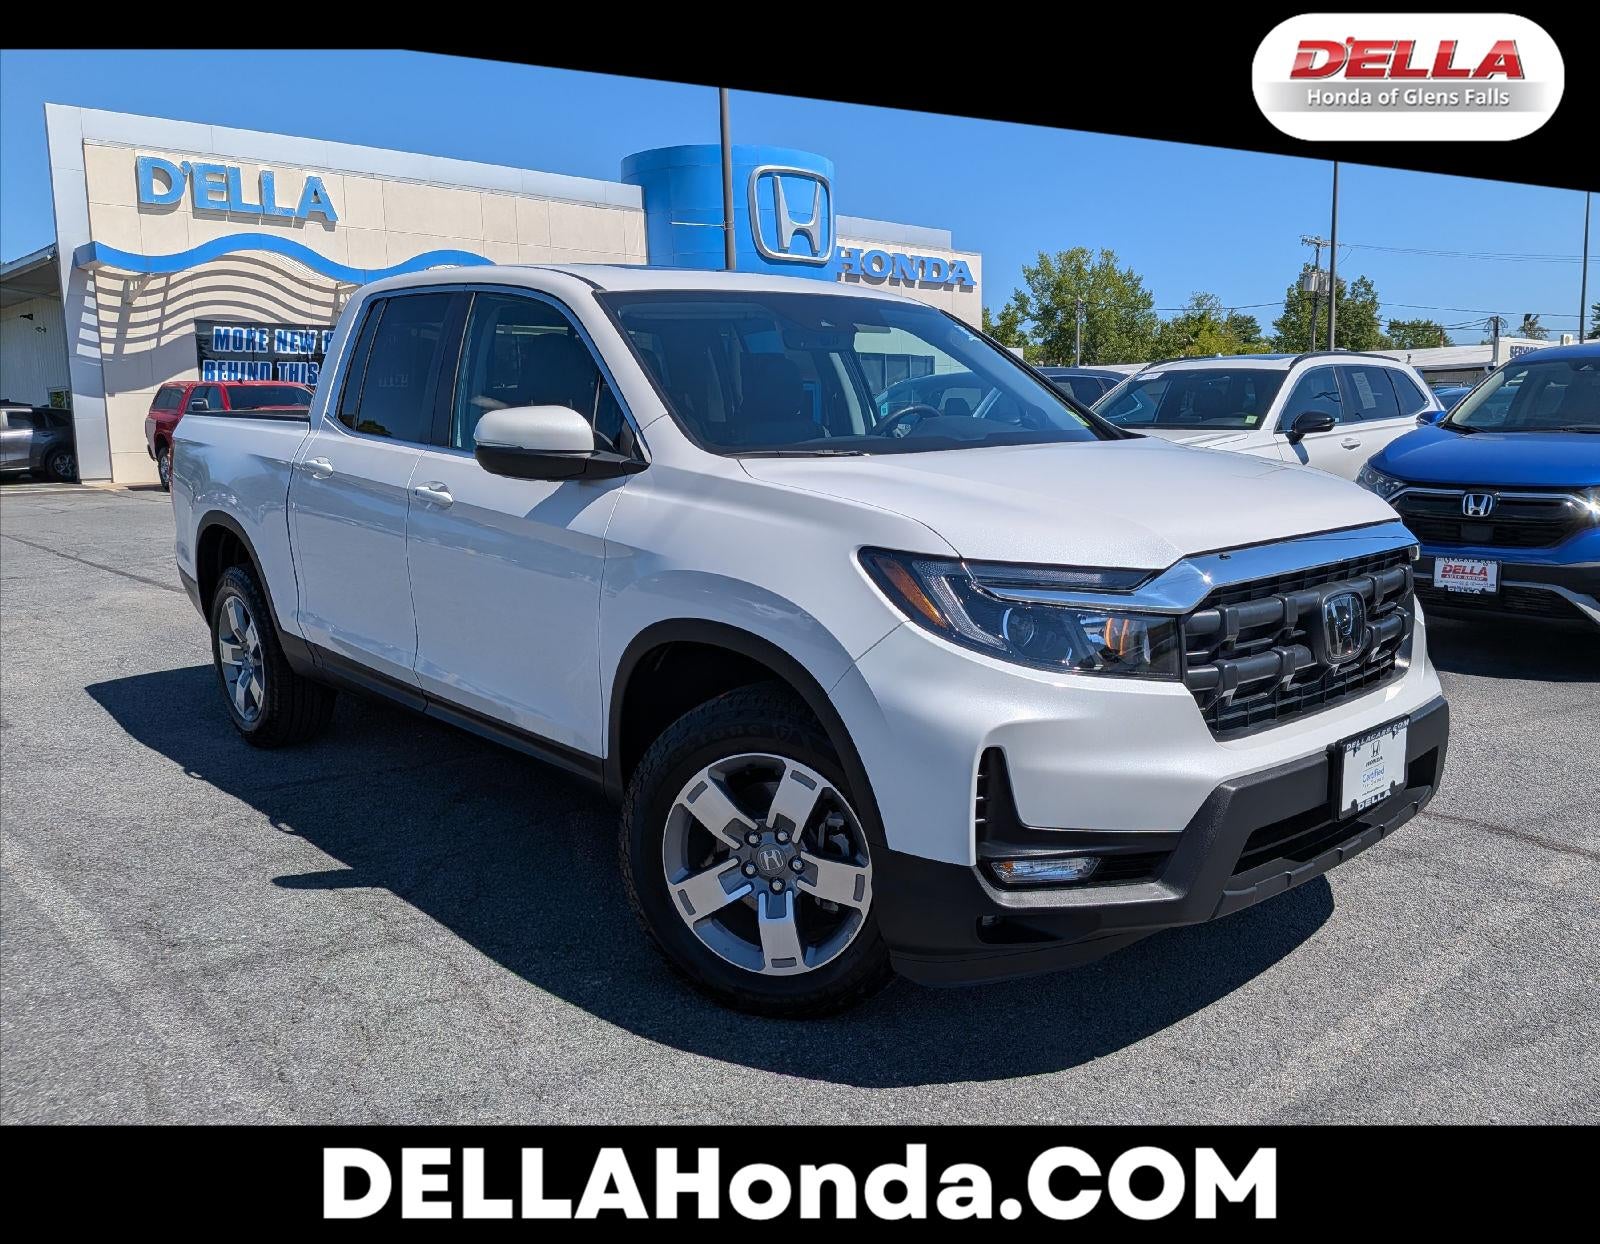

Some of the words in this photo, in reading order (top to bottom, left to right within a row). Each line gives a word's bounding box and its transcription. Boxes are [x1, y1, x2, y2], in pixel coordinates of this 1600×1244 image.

[136, 155, 339, 223] D'ELLA
[836, 246, 977, 288] HONDA
[213, 326, 269, 353] MORE
[274, 328, 318, 354] NEW
[202, 360, 273, 382] BEHIND
[277, 362, 320, 384] THIS
[1357, 789, 1391, 811] DELLA
